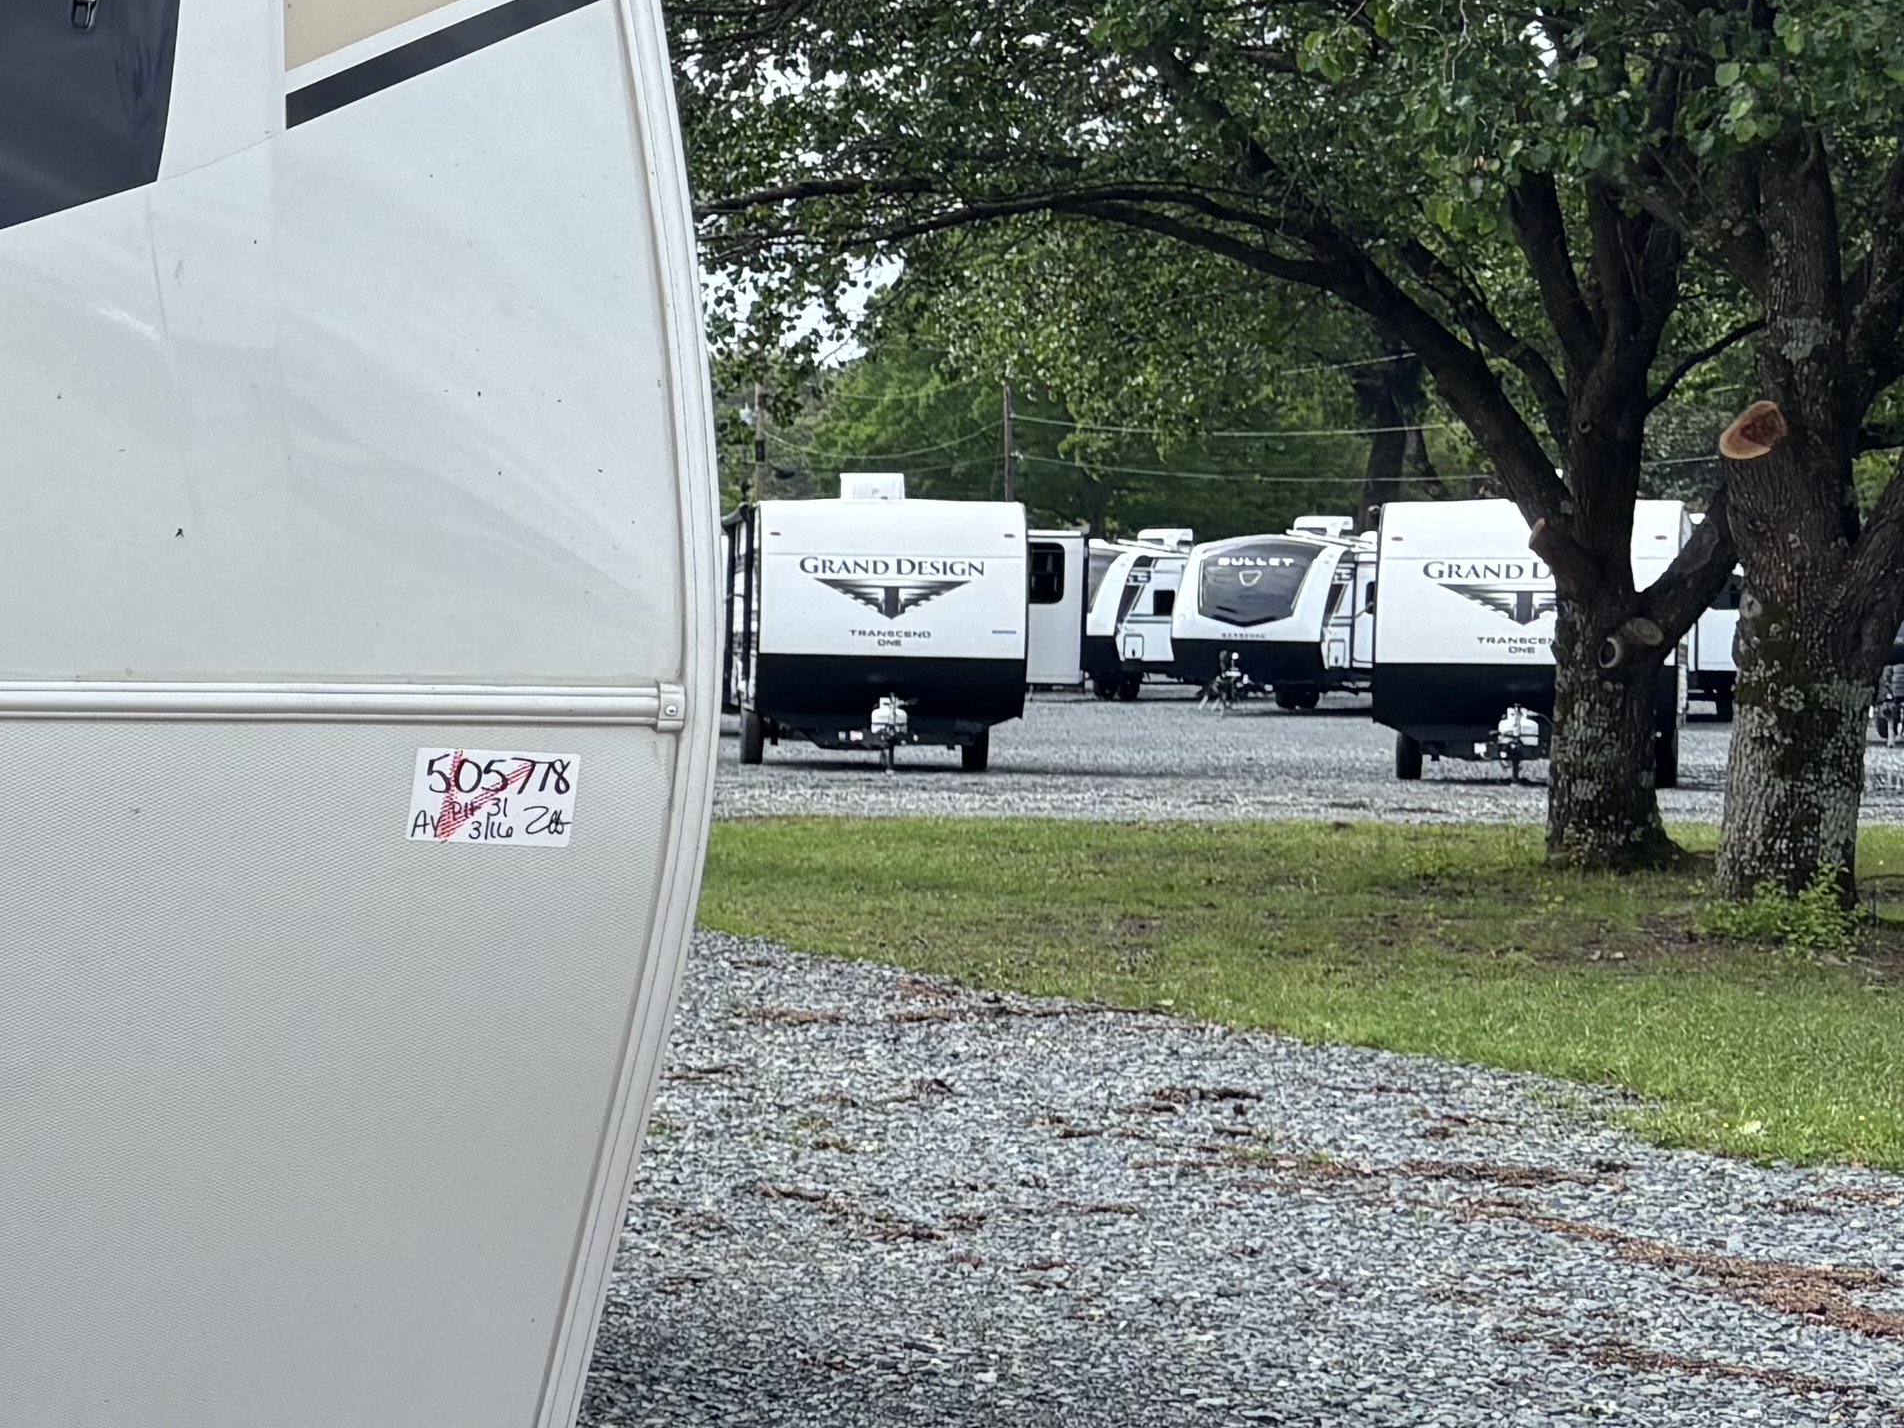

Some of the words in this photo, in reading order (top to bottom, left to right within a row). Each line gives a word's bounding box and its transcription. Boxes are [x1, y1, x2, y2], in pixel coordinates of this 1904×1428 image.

[799, 556, 889, 575] GRAND
[896, 558, 984, 576] DESIGN
[1423, 561, 1524, 579] GRAND
[850, 629, 931, 639] TRANSCEND
[1477, 636, 1555, 645] TRANSCEN
